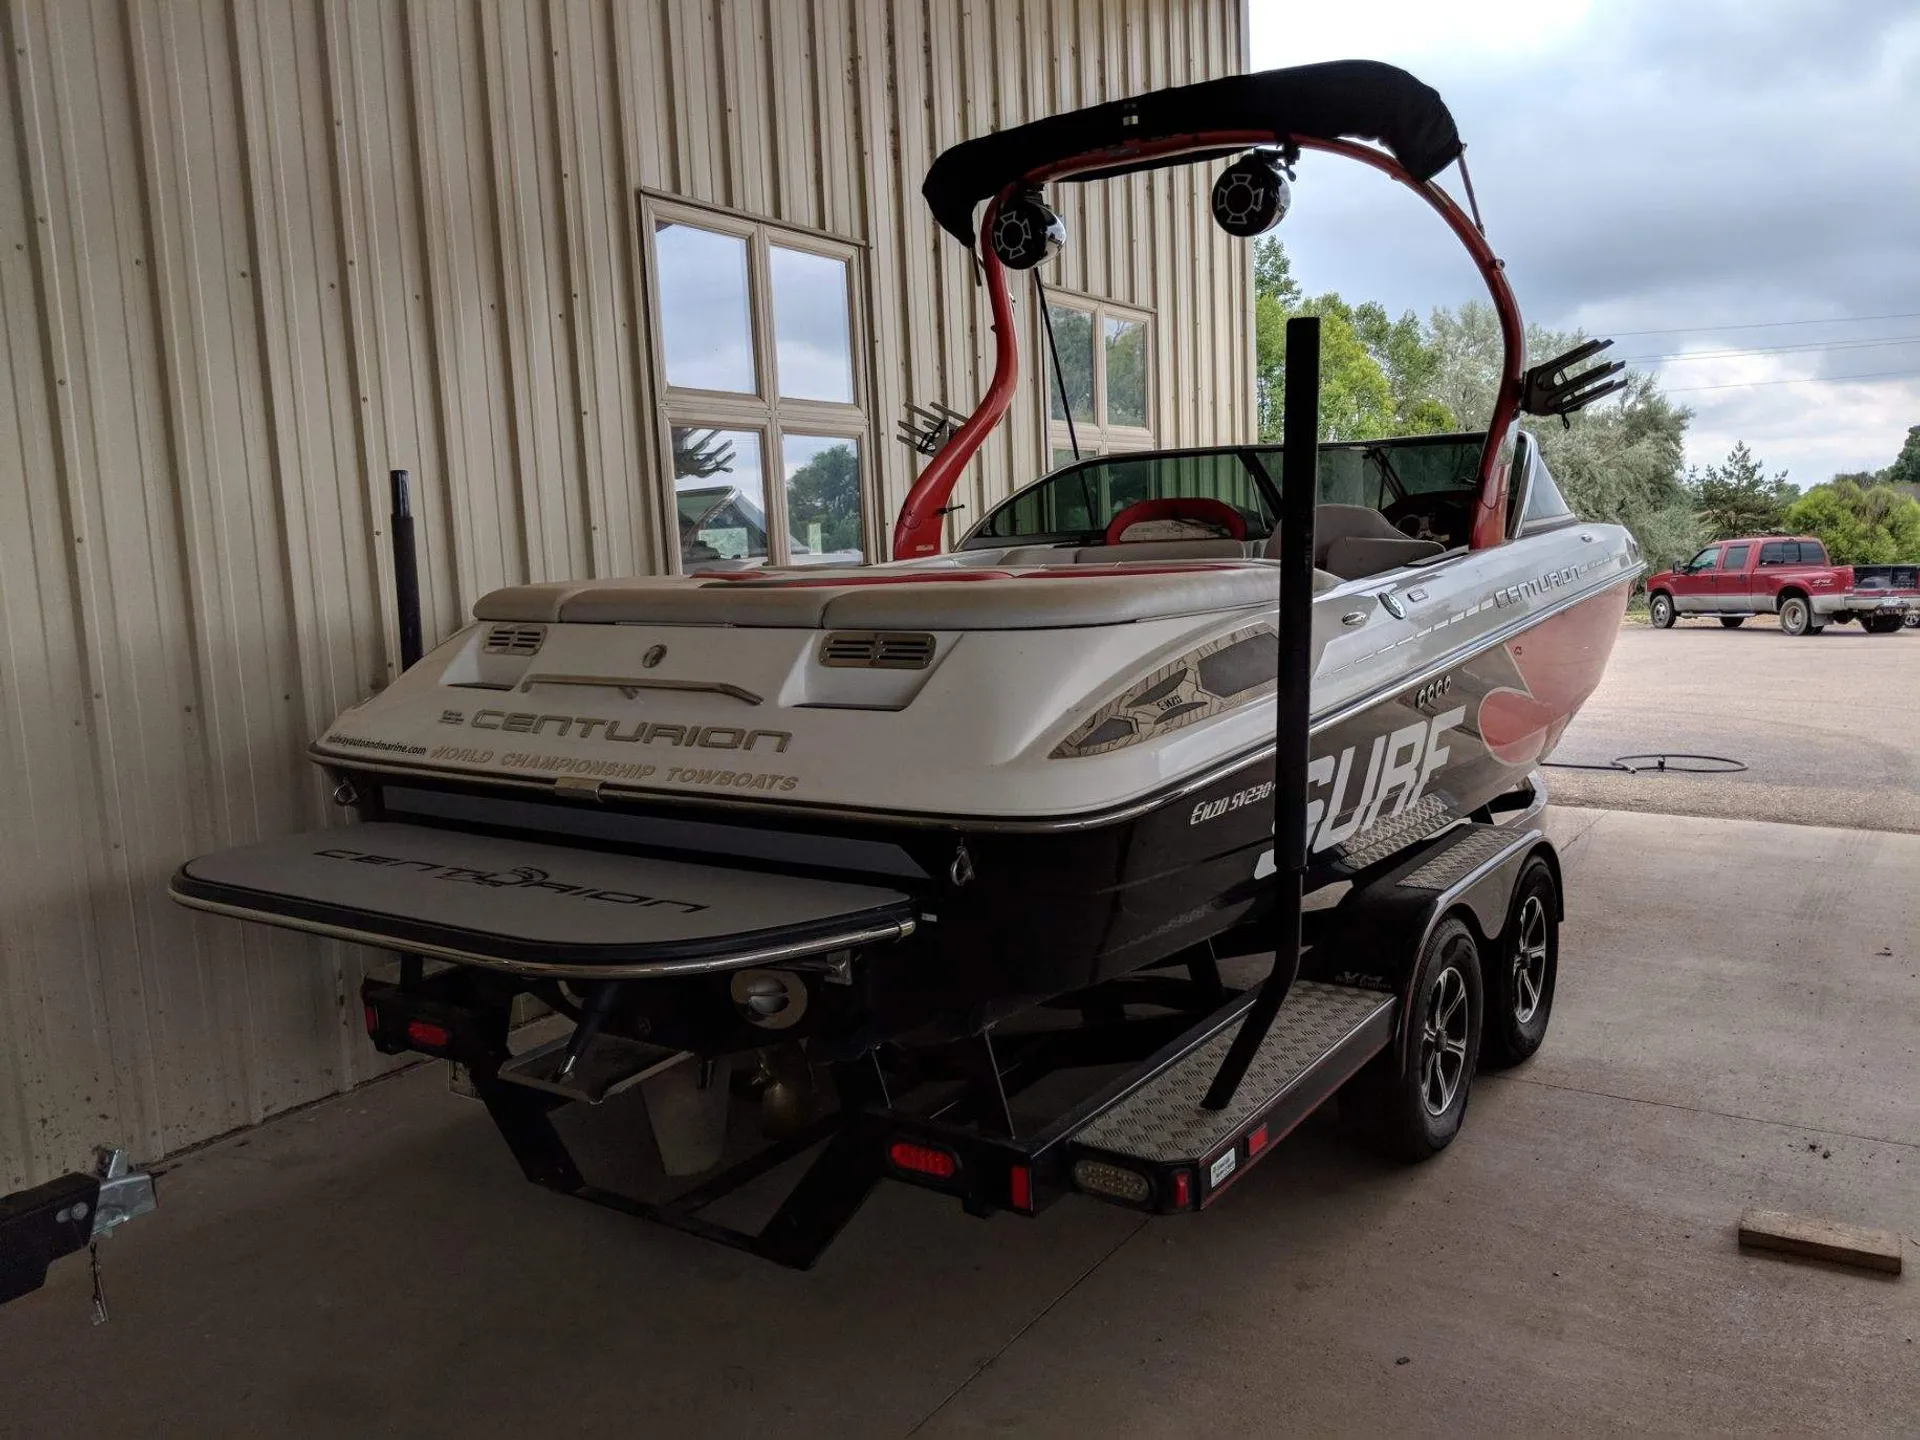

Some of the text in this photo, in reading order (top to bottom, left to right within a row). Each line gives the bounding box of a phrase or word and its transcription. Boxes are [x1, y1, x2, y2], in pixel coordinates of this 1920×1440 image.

[1494, 565, 1580, 608] CENTURION
[471, 709, 793, 753] CENTURION
[430, 747, 799, 792] WORLD CHAMPIONSHIP TOWBOATS
[1254, 705, 1467, 880] SURF
[313, 849, 710, 914] CENTURION
